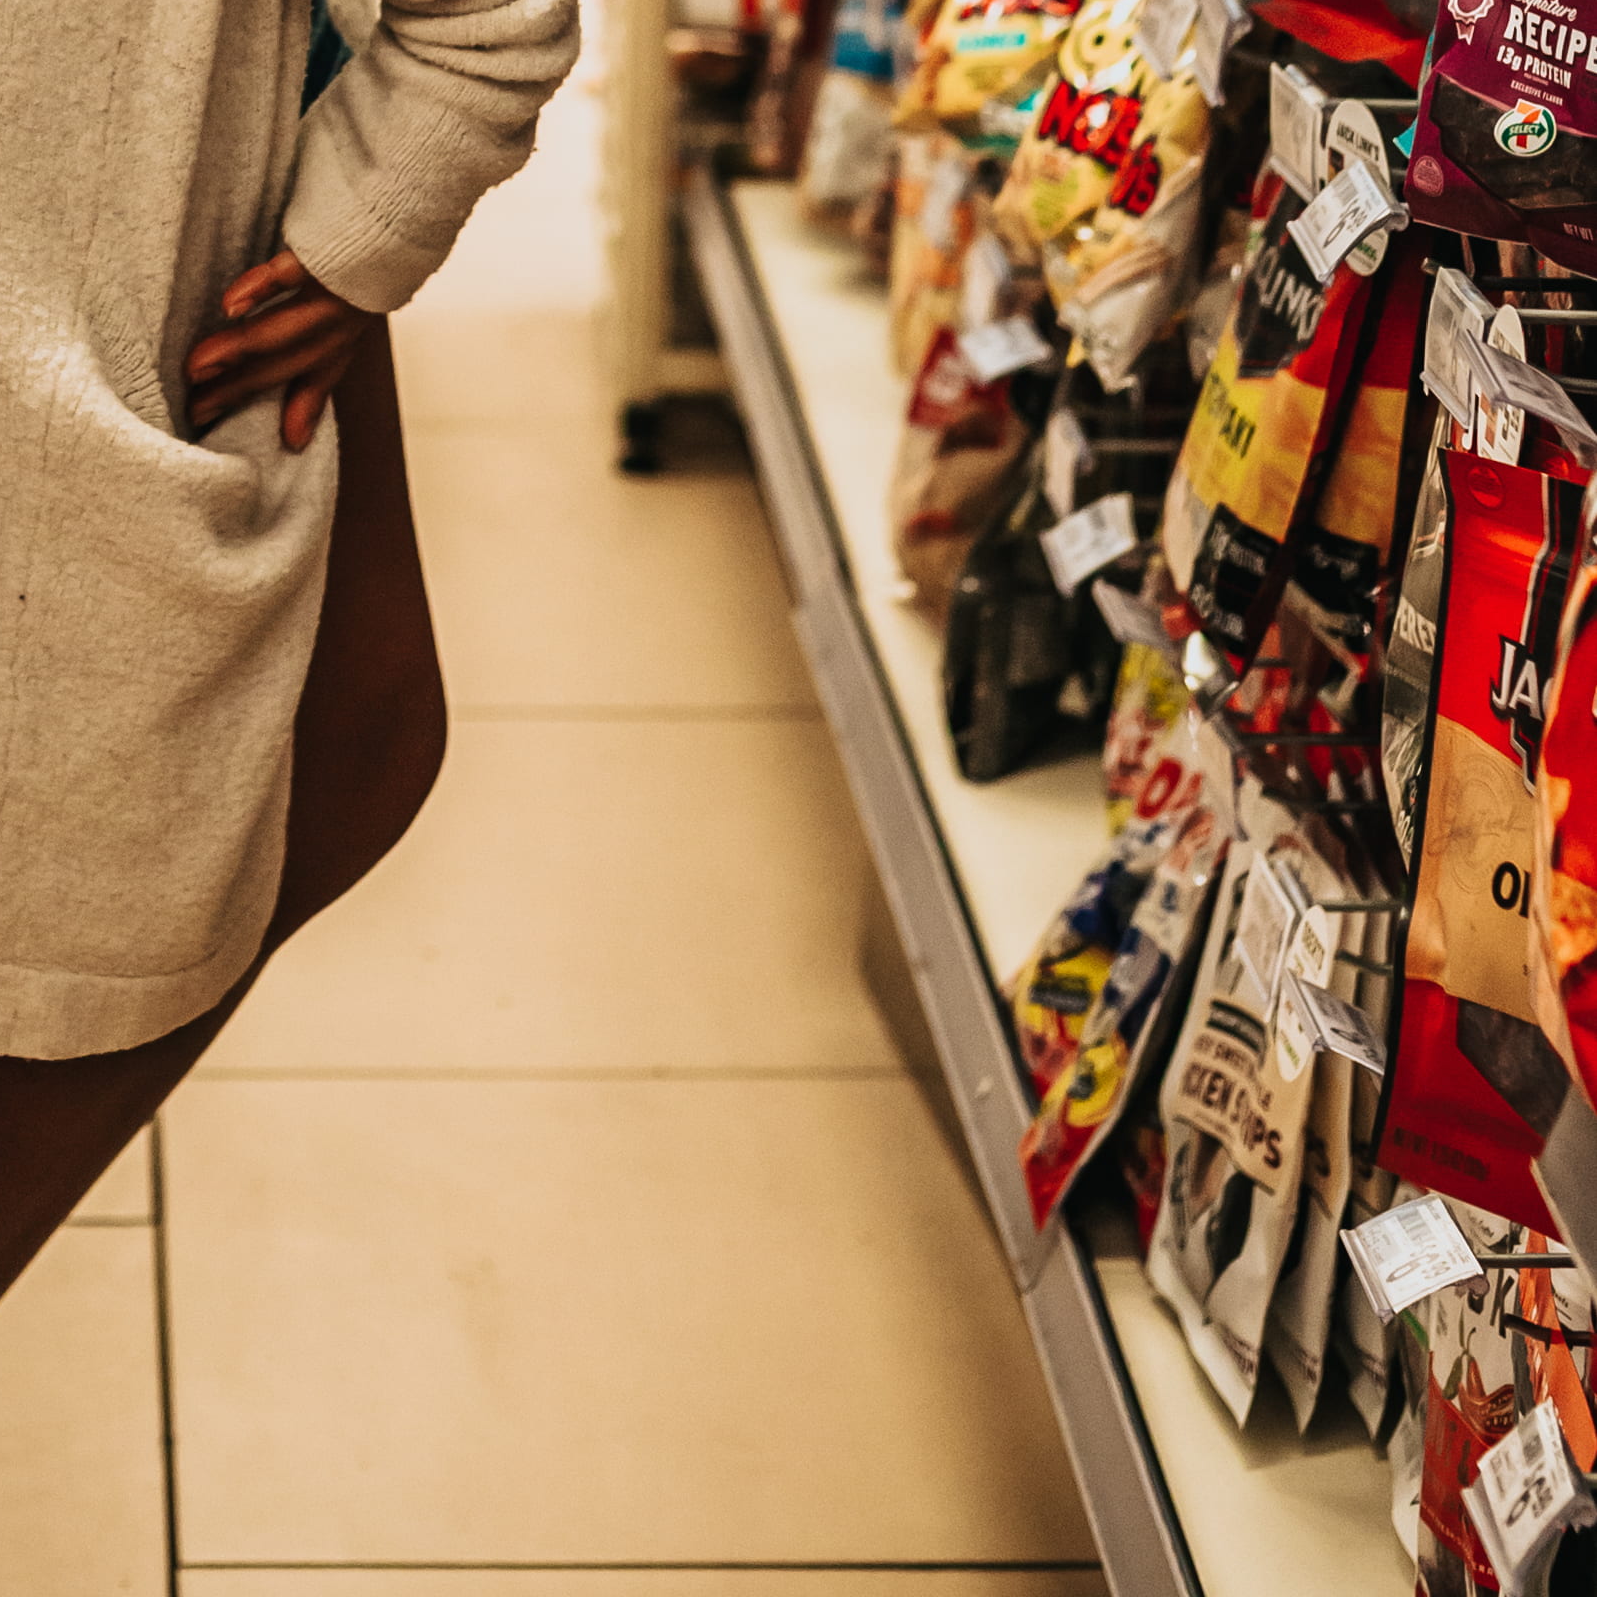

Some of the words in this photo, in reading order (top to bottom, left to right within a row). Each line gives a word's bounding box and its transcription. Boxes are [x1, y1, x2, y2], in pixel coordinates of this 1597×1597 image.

[1496, 45, 1523, 71] 13g
[1524, 54, 1572, 90] PROTEIN
[1509, 123, 1539, 136] SELECT
[1492, 641, 1554, 722] JA
